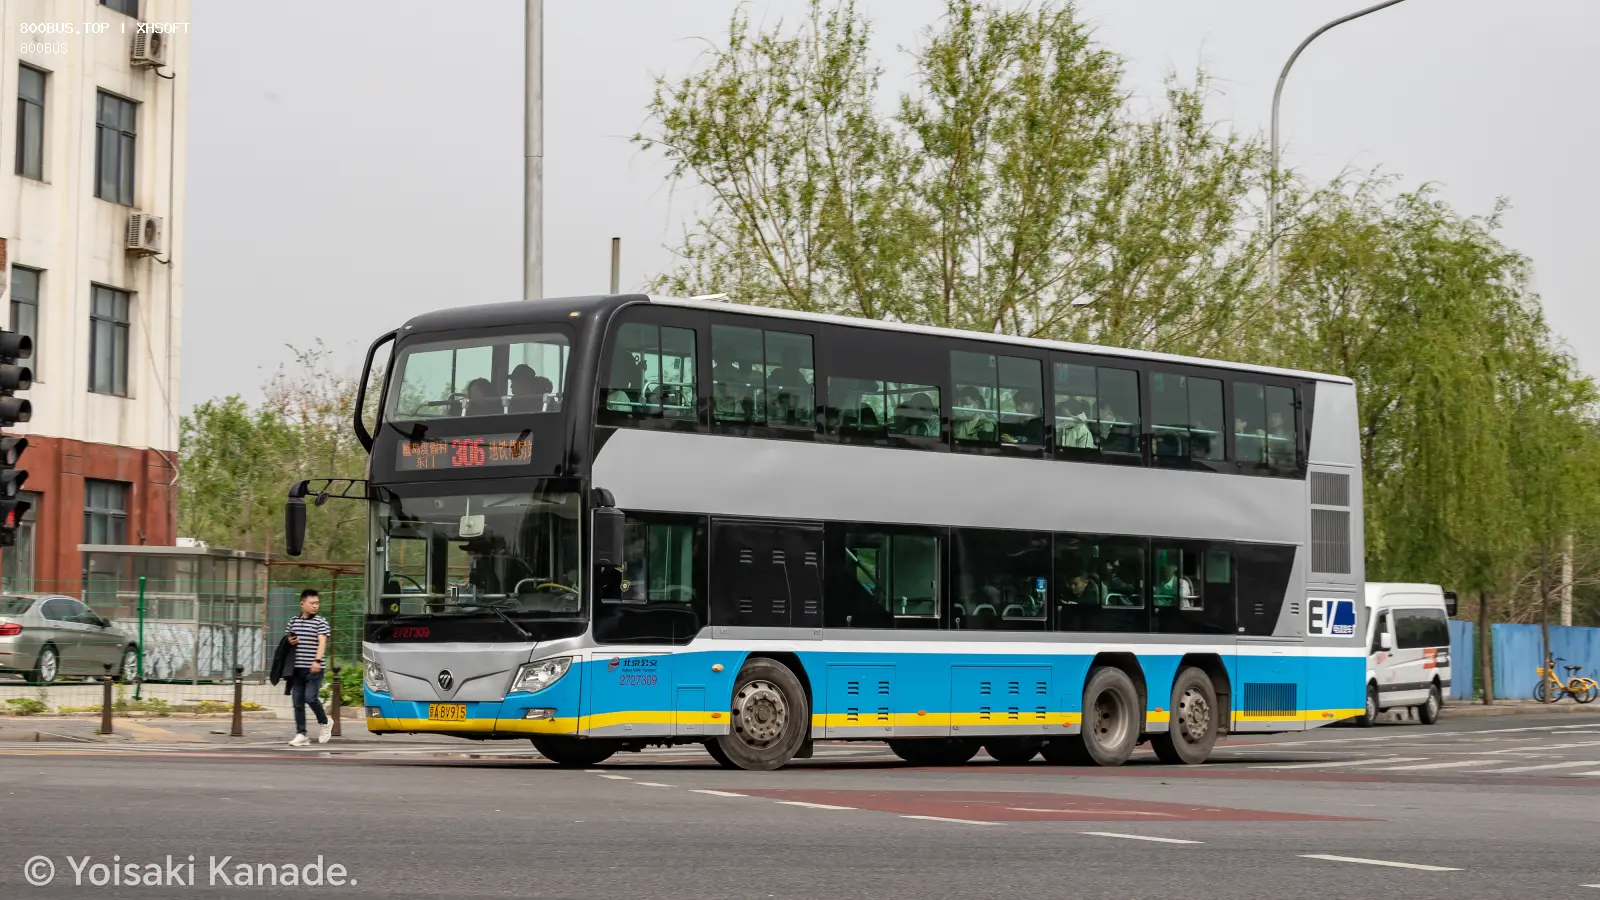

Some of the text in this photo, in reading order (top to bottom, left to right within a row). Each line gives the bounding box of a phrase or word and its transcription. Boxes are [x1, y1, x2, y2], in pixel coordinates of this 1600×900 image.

[451, 437, 486, 467] 306
[392, 626, 431, 639] 2727309
[622, 659, 658, 667] 北京公交
[619, 674, 658, 686] 2727309
